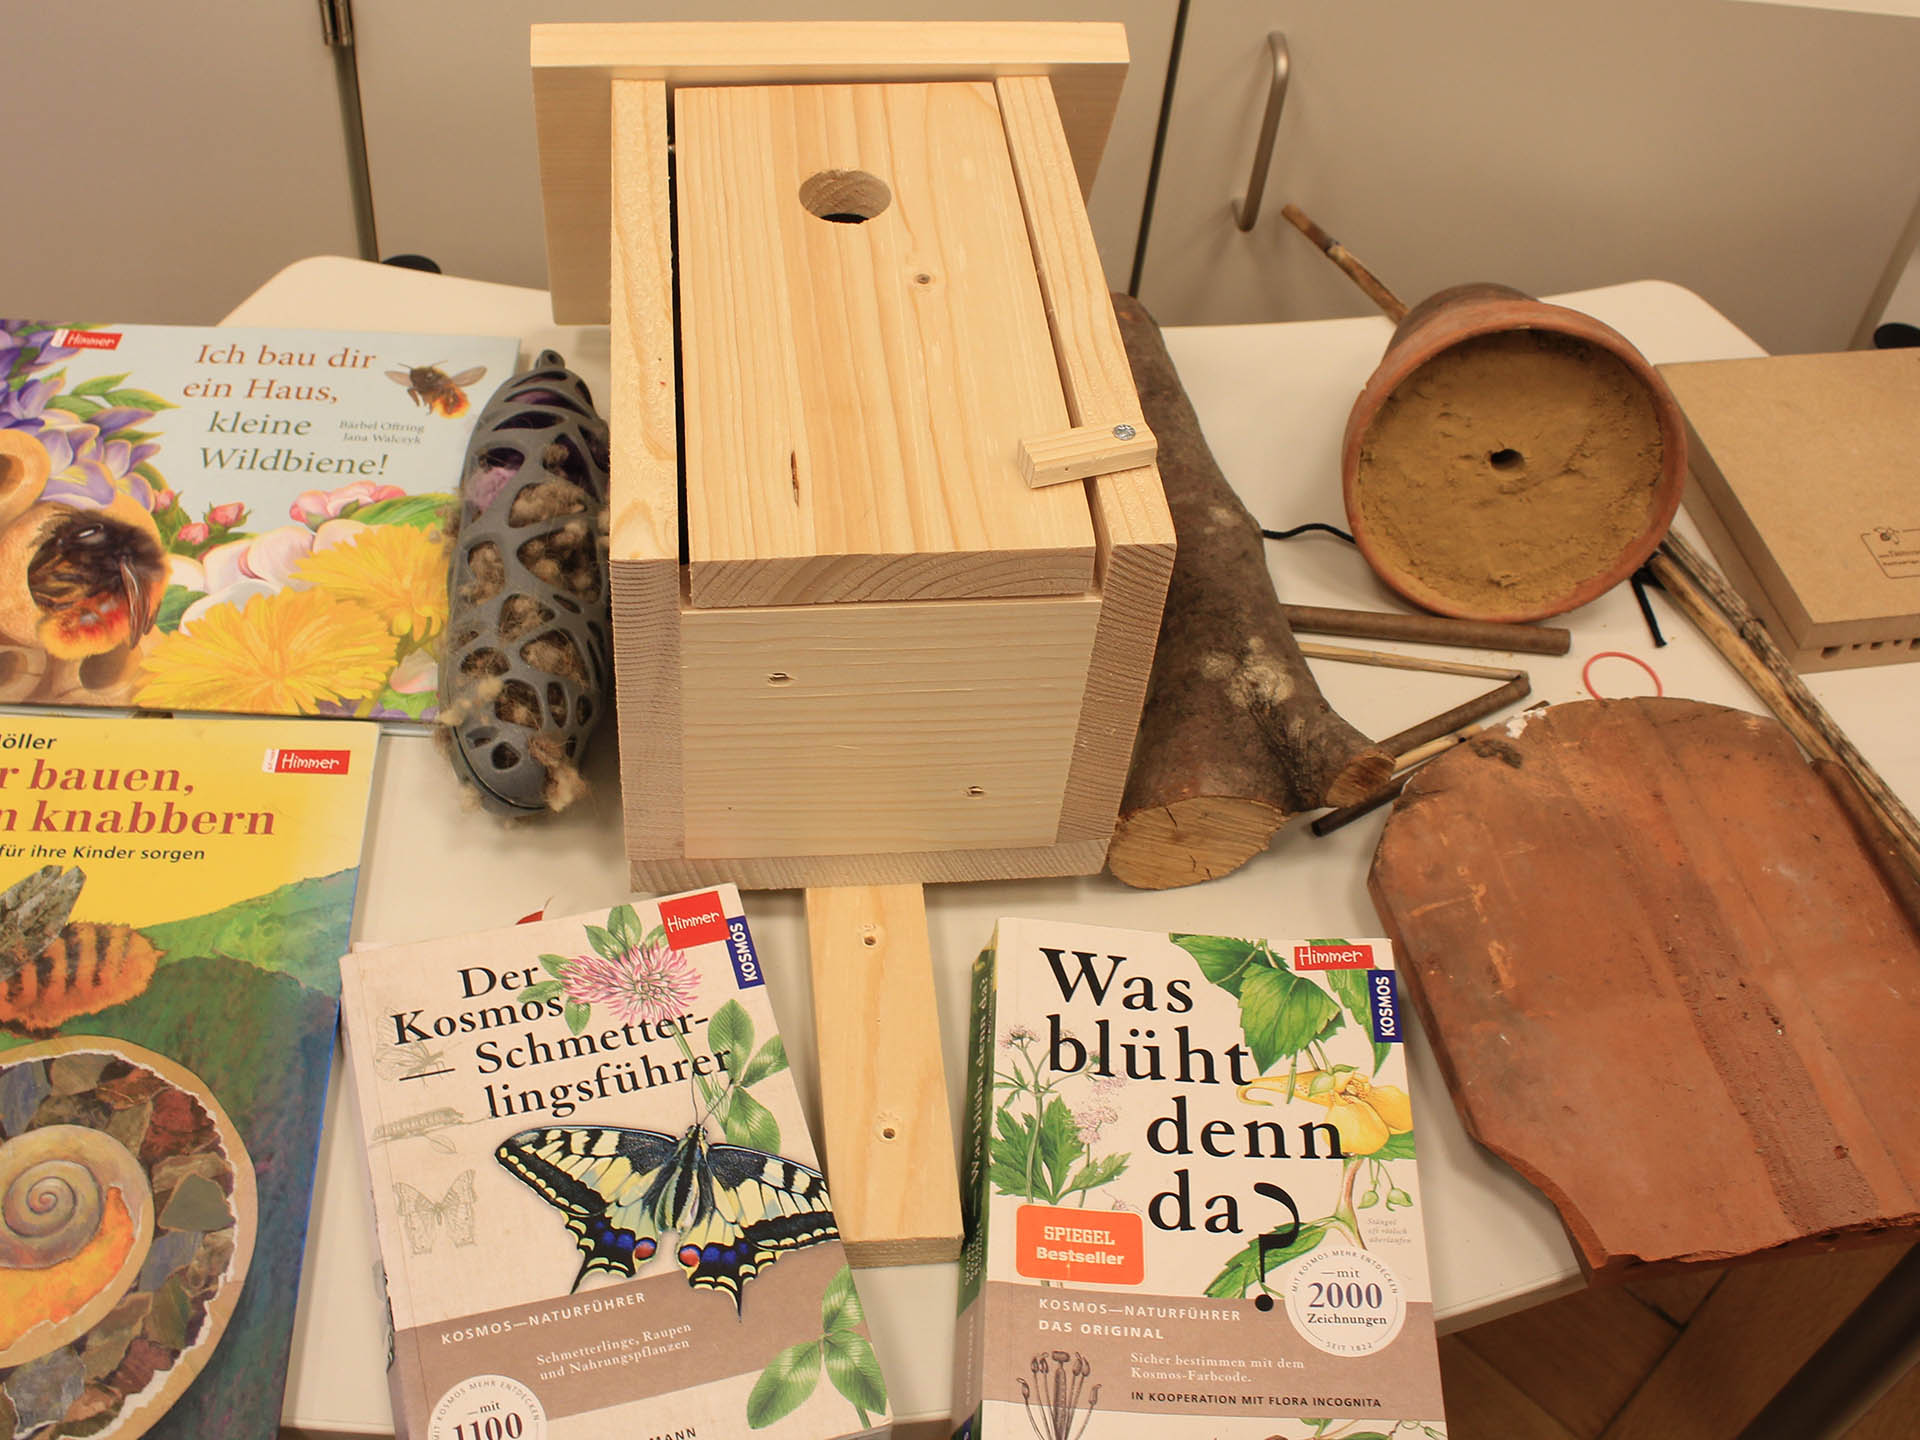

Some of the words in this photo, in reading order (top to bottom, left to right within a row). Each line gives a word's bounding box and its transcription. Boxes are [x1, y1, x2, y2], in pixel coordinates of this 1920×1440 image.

[195, 344, 245, 364] Ich
[257, 345, 316, 367] bau
[328, 348, 376, 368] dir
[183, 378, 232, 398] ein
[245, 379, 339, 404] Haus,
[207, 411, 312, 435] kleine
[201, 447, 388, 475] Wildbiene!
[0, 733, 57, 749] öller
[281, 752, 340, 770] Himmer
[28, 758, 194, 796] bauen,
[29, 800, 275, 836] knabbern
[0, 844, 25, 857] für
[30, 845, 66, 858] ihre
[73, 846, 135, 860] Kinder
[141, 849, 205, 863] sorgen
[667, 910, 720, 933] Himmer
[729, 922, 758, 983] KOSMOS
[1299, 949, 1363, 966] Himmer
[458, 964, 540, 999] Der
[1039, 948, 1195, 1014] Was
[1376, 975, 1396, 1037] KOSMOS
[390, 997, 565, 1046] Kosmos
[475, 1011, 710, 1075] Schmetter-
[1046, 1014, 1252, 1086] blüht
[484, 1048, 731, 1120] lingsführer
[1147, 1096, 1348, 1160] denn
[1044, 1226, 1115, 1246] SPIEGEL
[1036, 1247, 1125, 1266] Bestseller
[1298, 1252, 1329, 1276] KOSMOS
[1332, 1249, 1357, 1257] MEHR
[1307, 1282, 1383, 1309] 2000
[1039, 1319, 1073, 1333] DAS
[1080, 1324, 1164, 1340] ORIGINAL
[1307, 1313, 1387, 1327] Zeichnungen
[536, 1335, 640, 1366] Schmetterlinge,
[642, 1323, 692, 1342] Raupen
[540, 1366, 566, 1380] und
[569, 1339, 690, 1374] Nahrungspflanzen
[1130, 1352, 1171, 1365] Sicher
[1175, 1354, 1246, 1368] bestimmen
[1250, 1358, 1273, 1368] mit
[1277, 1357, 1305, 1369] dem
[1130, 1366, 1252, 1384] Kosmos-Farbcode.
[1131, 1391, 1144, 1401] IN
[1149, 1392, 1237, 1405] KOOPERATION
[1241, 1395, 1265, 1405] MIT
[1269, 1396, 1308, 1407] FLORA
[1313, 1397, 1381, 1408] INCOGNITA
[453, 1412, 523, 1440] 1100
